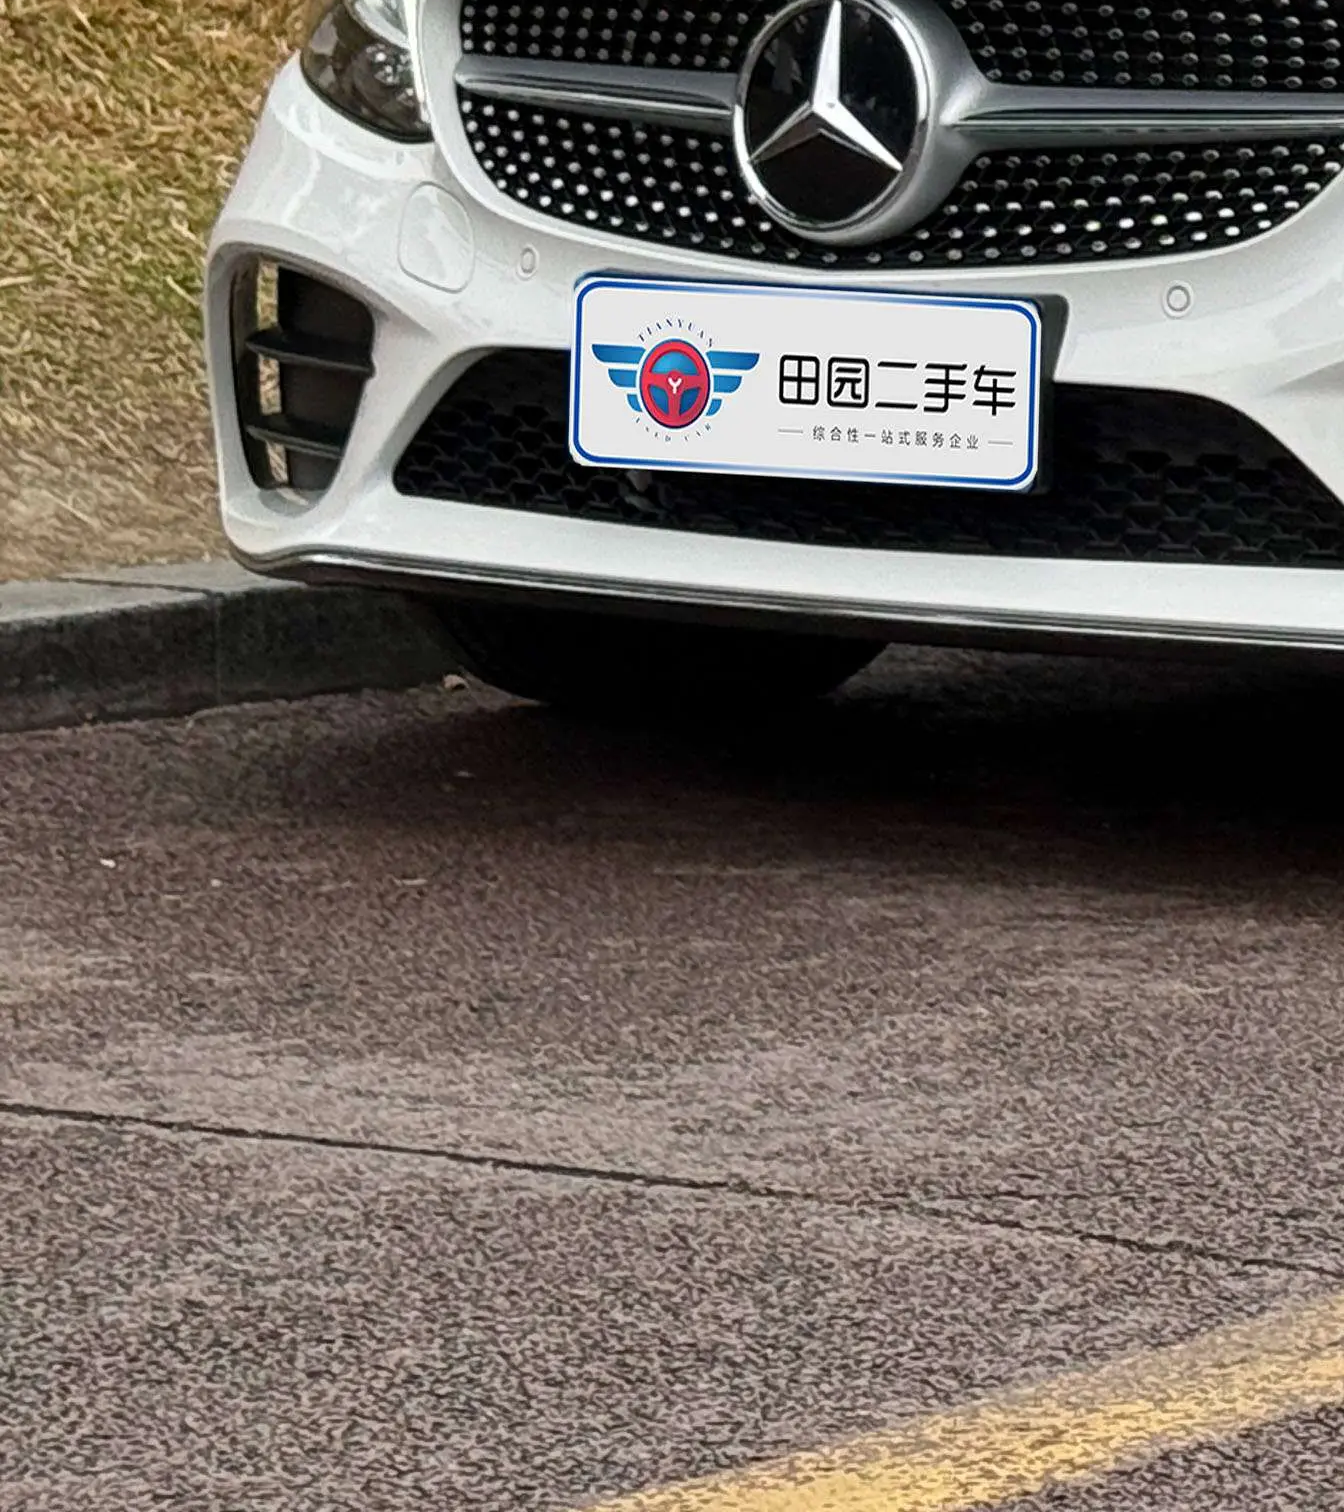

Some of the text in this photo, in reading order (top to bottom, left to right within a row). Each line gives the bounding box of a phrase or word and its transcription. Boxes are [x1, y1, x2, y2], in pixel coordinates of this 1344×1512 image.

[778, 354, 1017, 417] 田园二手车
[812, 424, 979, 450] 综合性一站式服务企业
